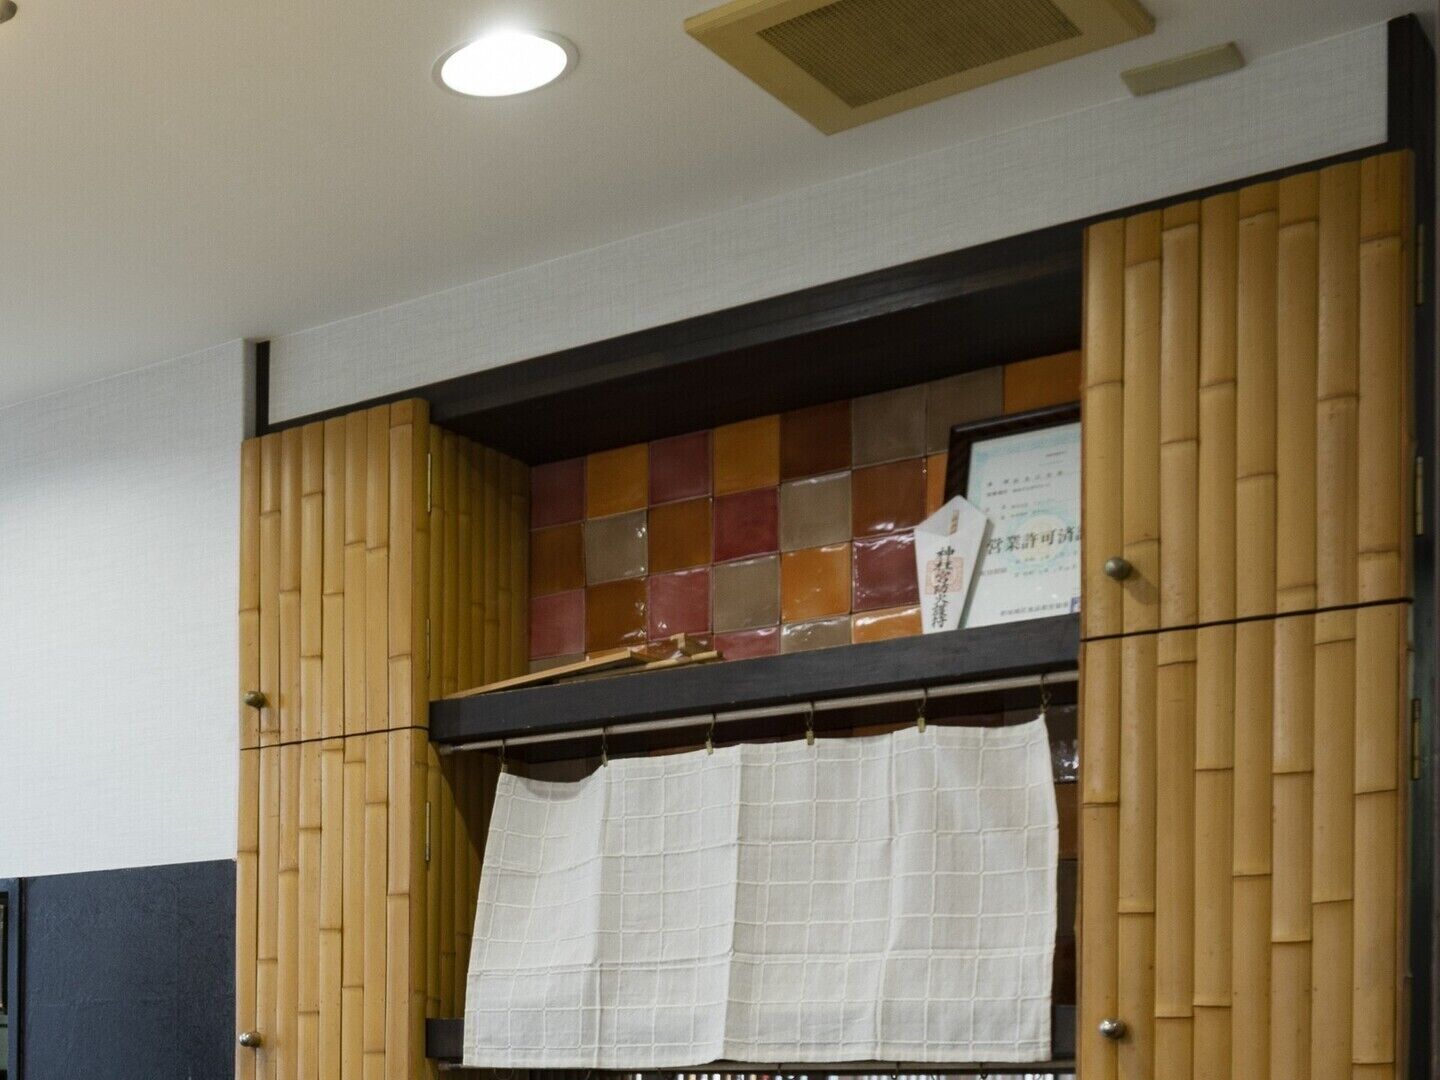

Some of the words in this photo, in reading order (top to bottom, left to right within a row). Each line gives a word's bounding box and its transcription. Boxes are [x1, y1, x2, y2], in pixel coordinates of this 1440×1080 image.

[986, 526, 1080, 555] 営業許可済
